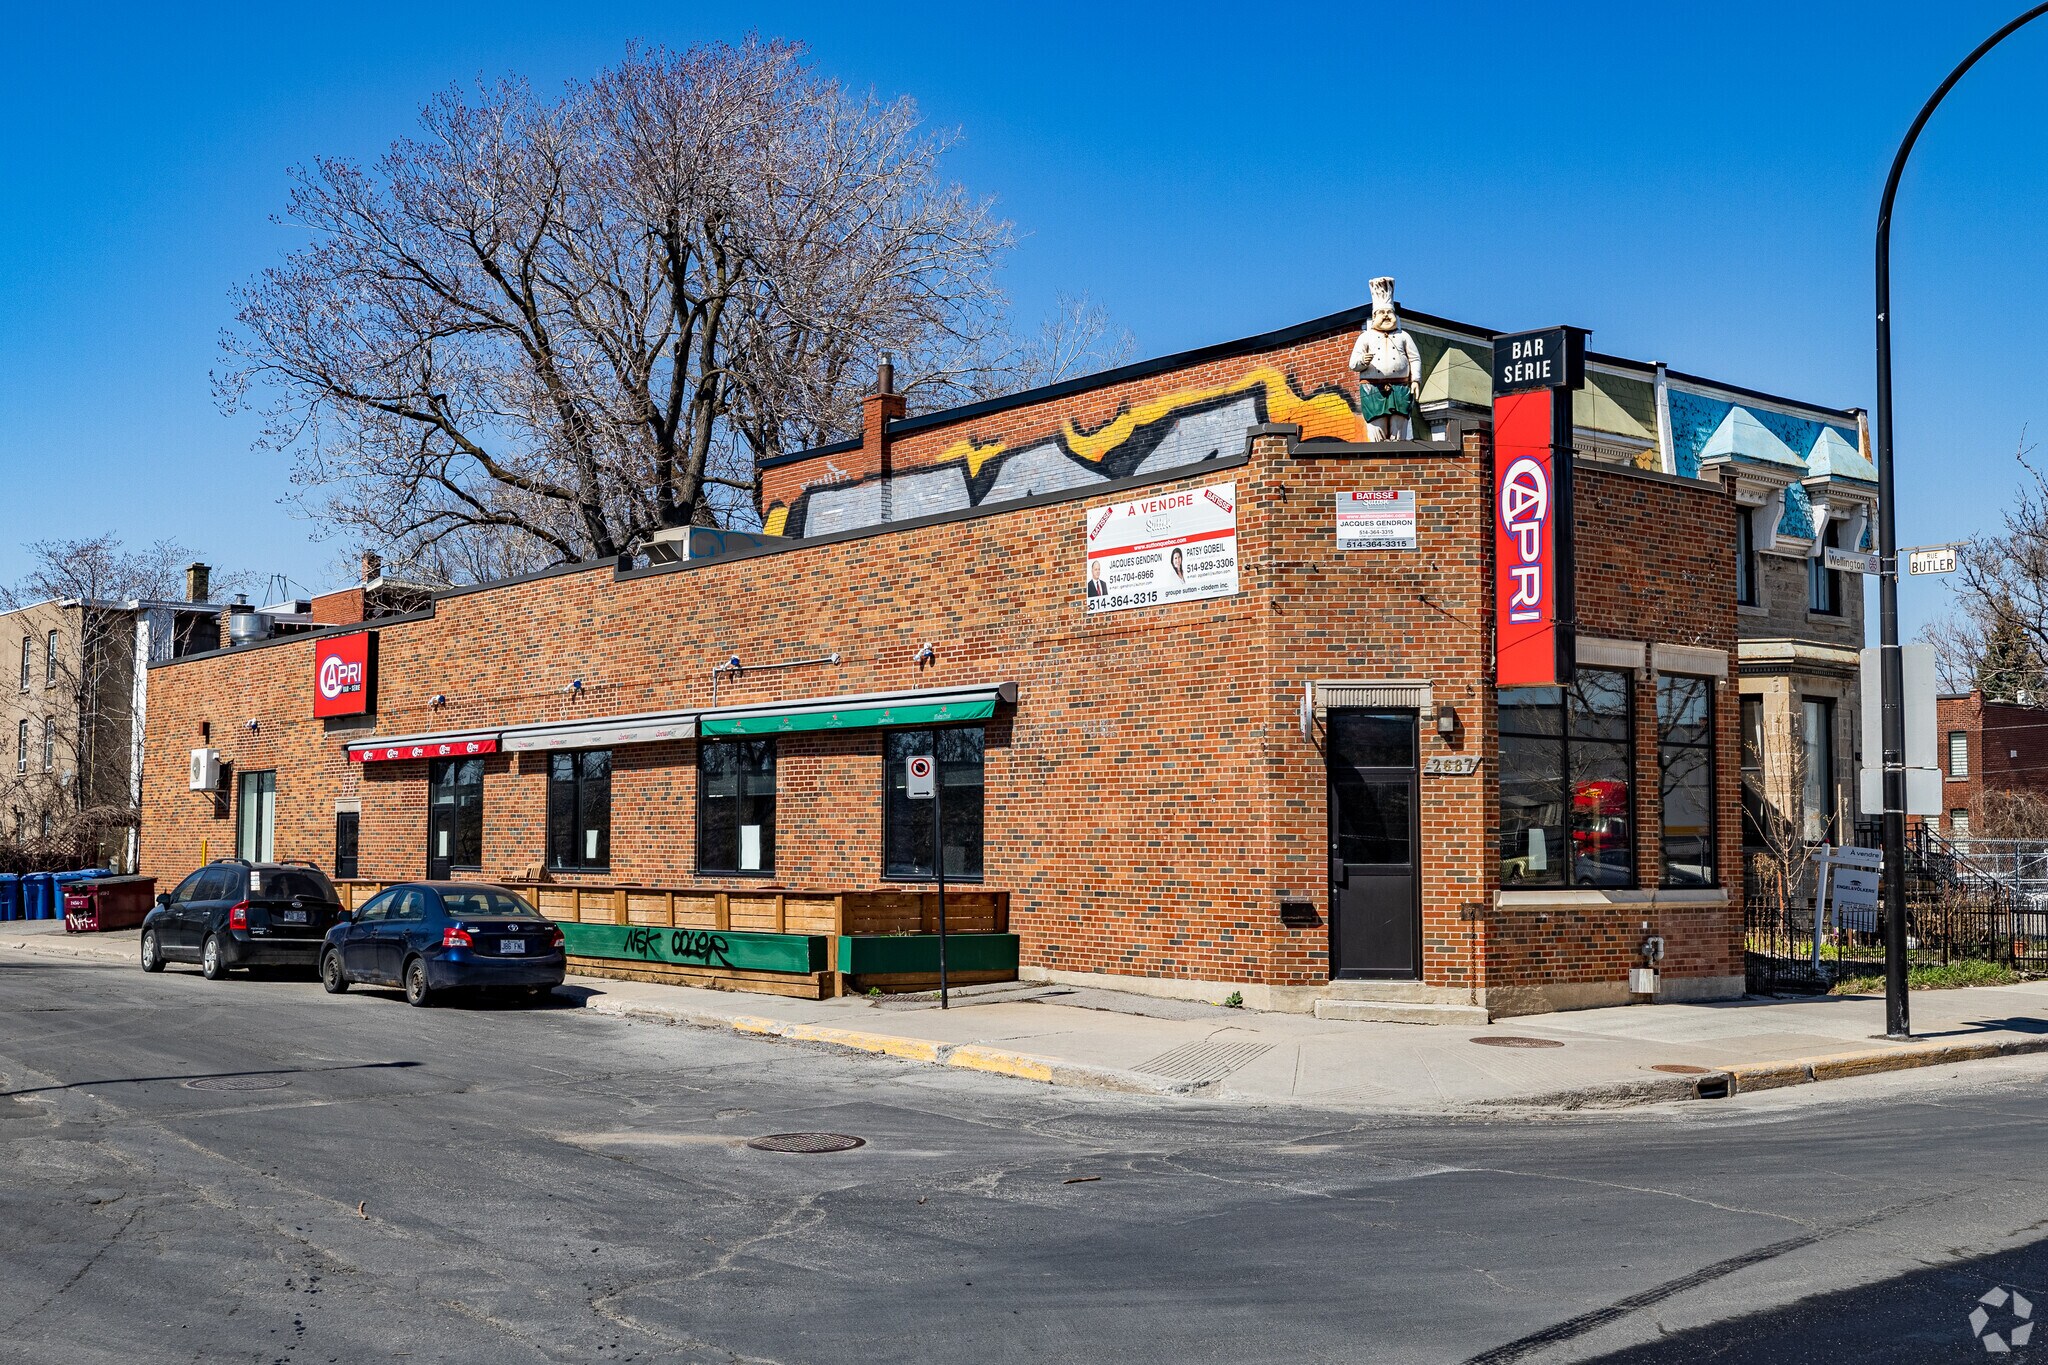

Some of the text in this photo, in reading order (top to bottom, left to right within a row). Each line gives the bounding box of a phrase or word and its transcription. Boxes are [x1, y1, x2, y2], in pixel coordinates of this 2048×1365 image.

[1512, 338, 1544, 360] BAR
[1503, 359, 1552, 384] SÉRIE
[1206, 490, 1231, 511] BATISSE
[1356, 492, 1394, 500] BATISSE
[1128, 494, 1193, 516] À VENDRE
[1092, 510, 1112, 538] BATISSE
[1500, 456, 1550, 624] CAPRI
[1186, 546, 1202, 557] PATSY
[1204, 543, 1225, 554] GOBEIL
[1109, 553, 1163, 569] JACQUES GENDRON
[1186, 558, 1234, 573] 514-929-3306
[1828, 555, 1865, 570] Wellington
[1912, 559, 1954, 573] BUTLER
[1109, 569, 1154, 584] 514-704-6966
[1089, 591, 1158, 610] 514-364-3315
[320, 654, 362, 700] CAPRI
[1857, 851, 1880, 859] vendre
